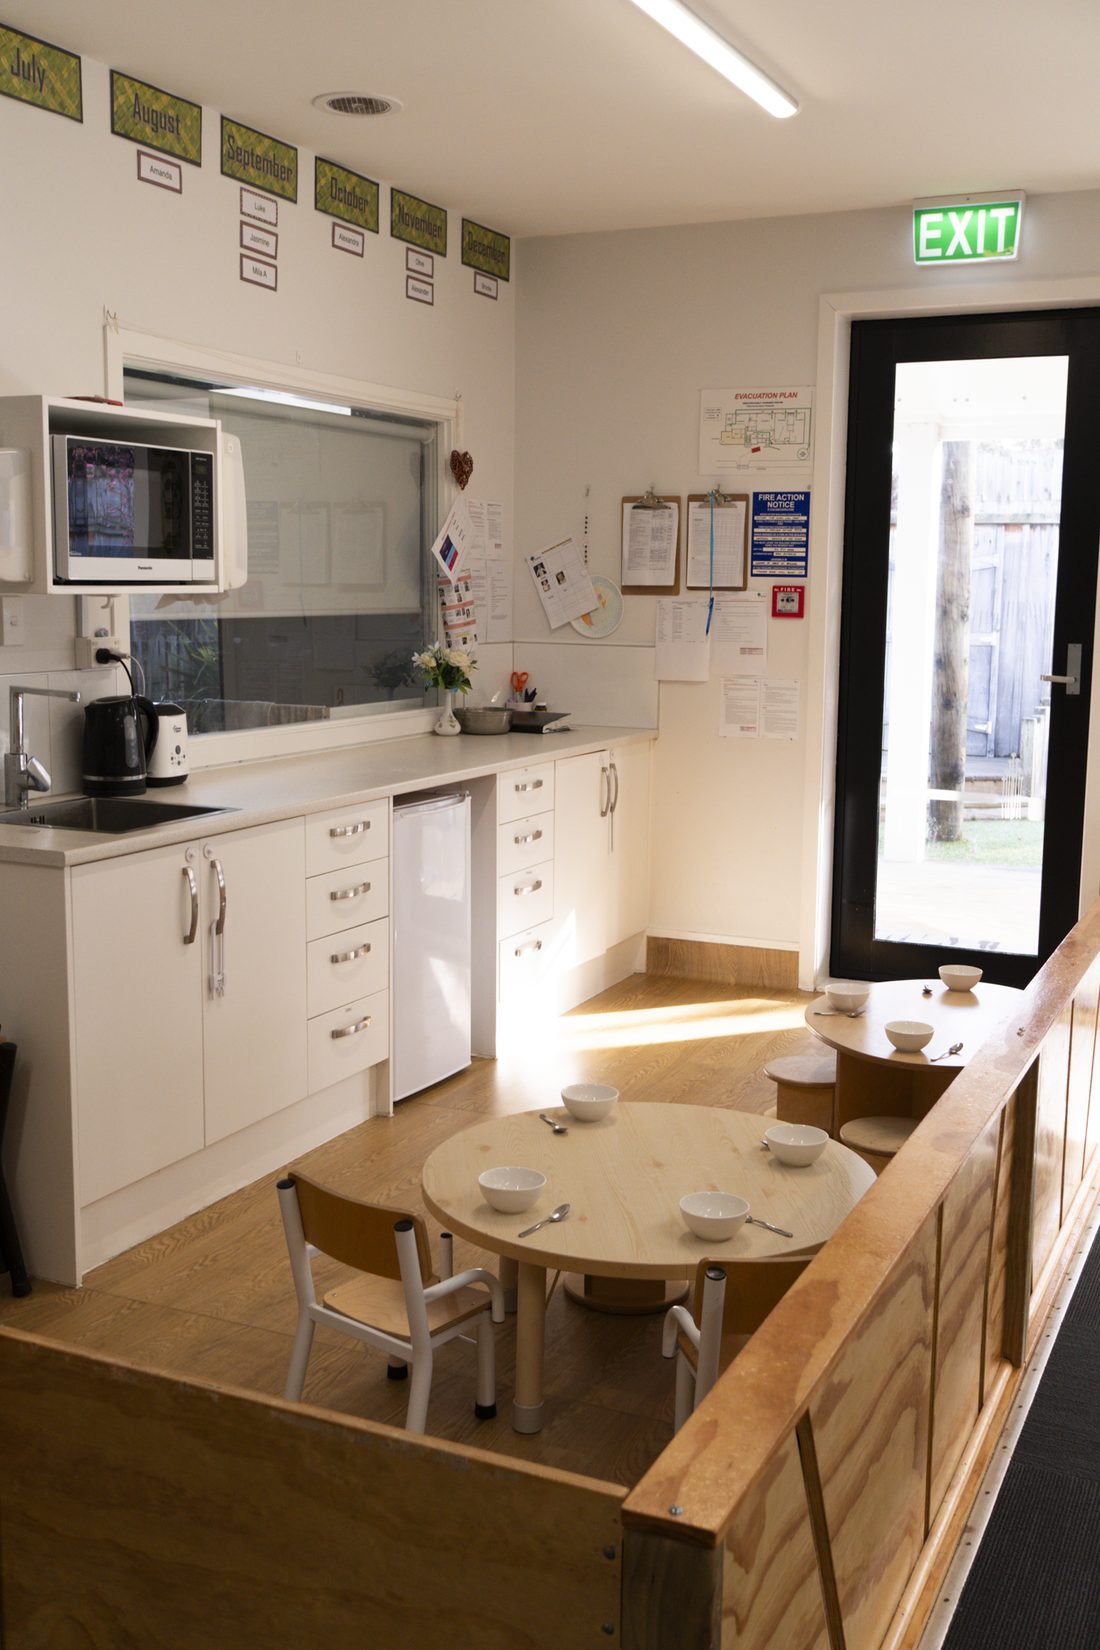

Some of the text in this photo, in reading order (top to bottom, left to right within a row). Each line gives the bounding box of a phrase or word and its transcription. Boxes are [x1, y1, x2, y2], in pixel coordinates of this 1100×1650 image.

[11, 48, 46, 92] July
[133, 93, 181, 136] August
[150, 165, 173, 181] Amanda
[227, 135, 293, 183] September
[330, 177, 369, 213] October
[398, 204, 443, 239] November
[919, 207, 1015, 257] EXIT
[250, 232, 270, 248] Jasmine
[467, 232, 506, 263] December
[263, 270, 268, 279] A
